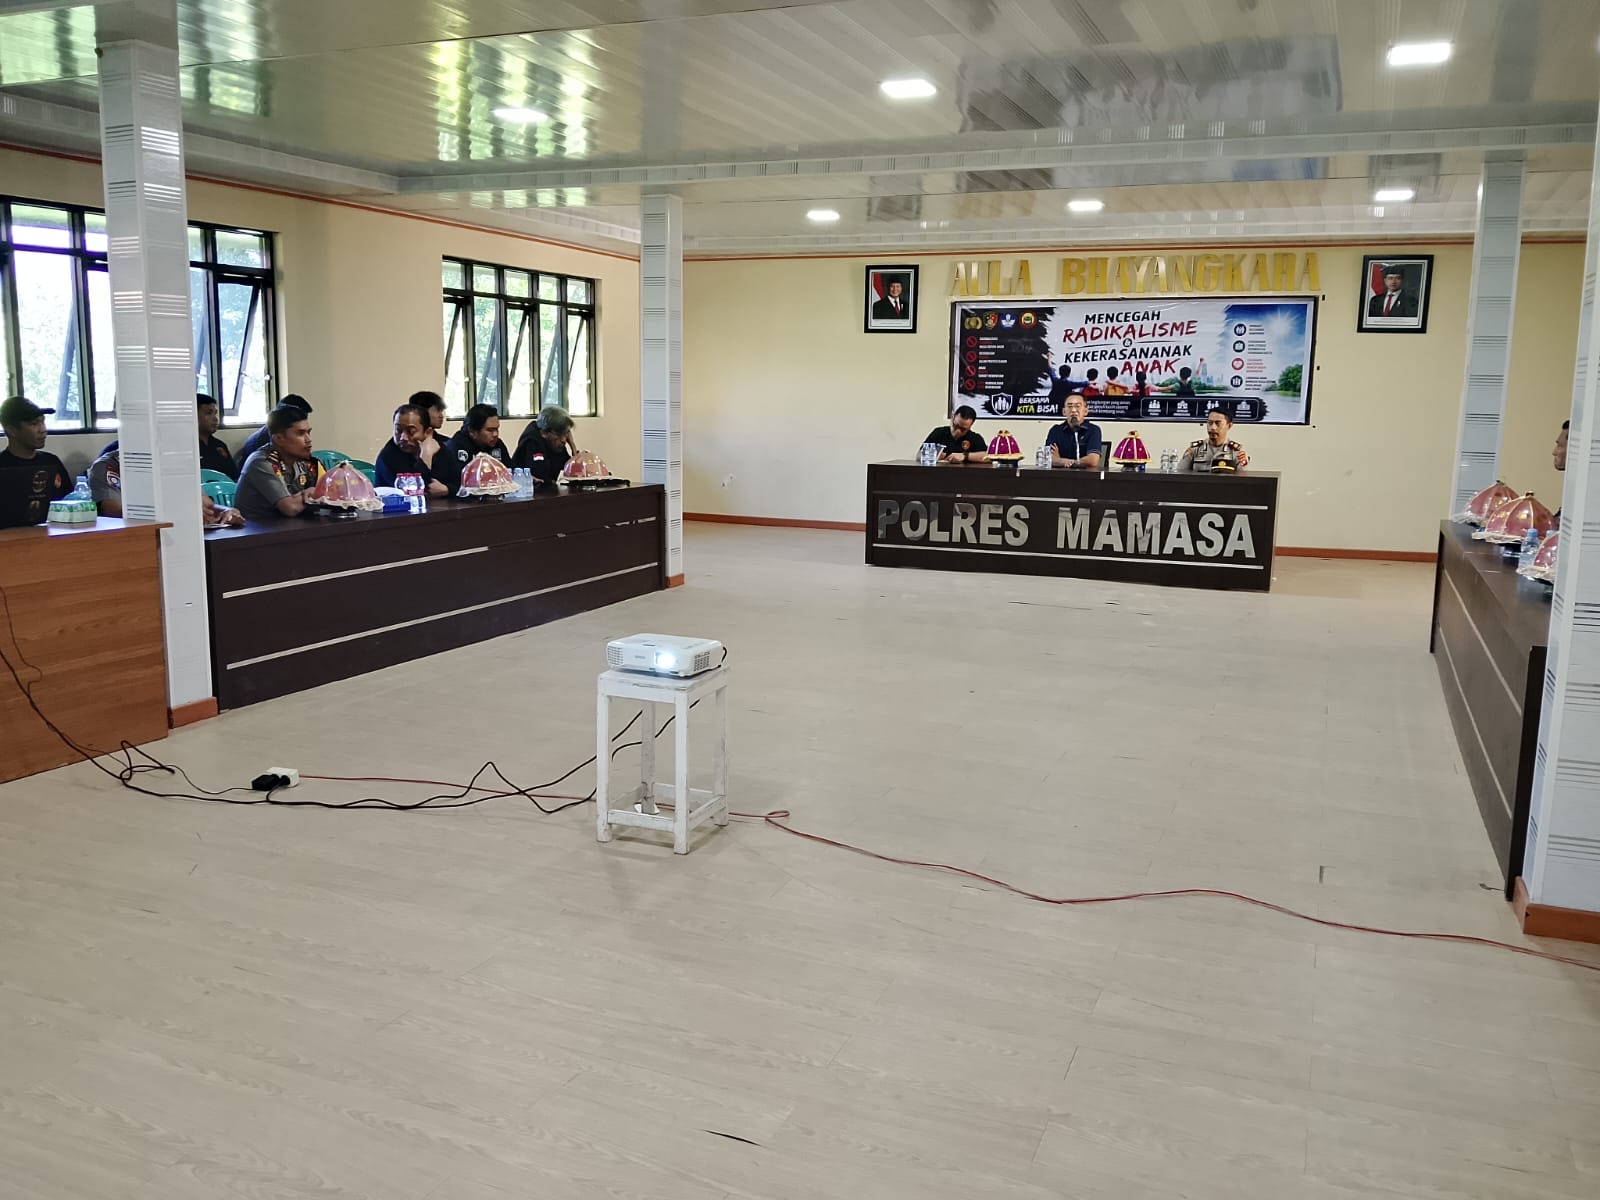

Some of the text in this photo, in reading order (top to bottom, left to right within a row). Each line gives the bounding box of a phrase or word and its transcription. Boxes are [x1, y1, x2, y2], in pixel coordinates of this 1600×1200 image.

[950, 260, 1032, 296] AULA
[1085, 311, 1161, 325] MENCEGAH
[1063, 320, 1198, 344] RADIKALISME
[1065, 345, 1193, 364] KEKERASANANAK
[1121, 358, 1181, 376] ANAK
[1017, 404, 1059, 414] KITA BISA!
[876, 500, 1256, 558] POLRES MAMASA
